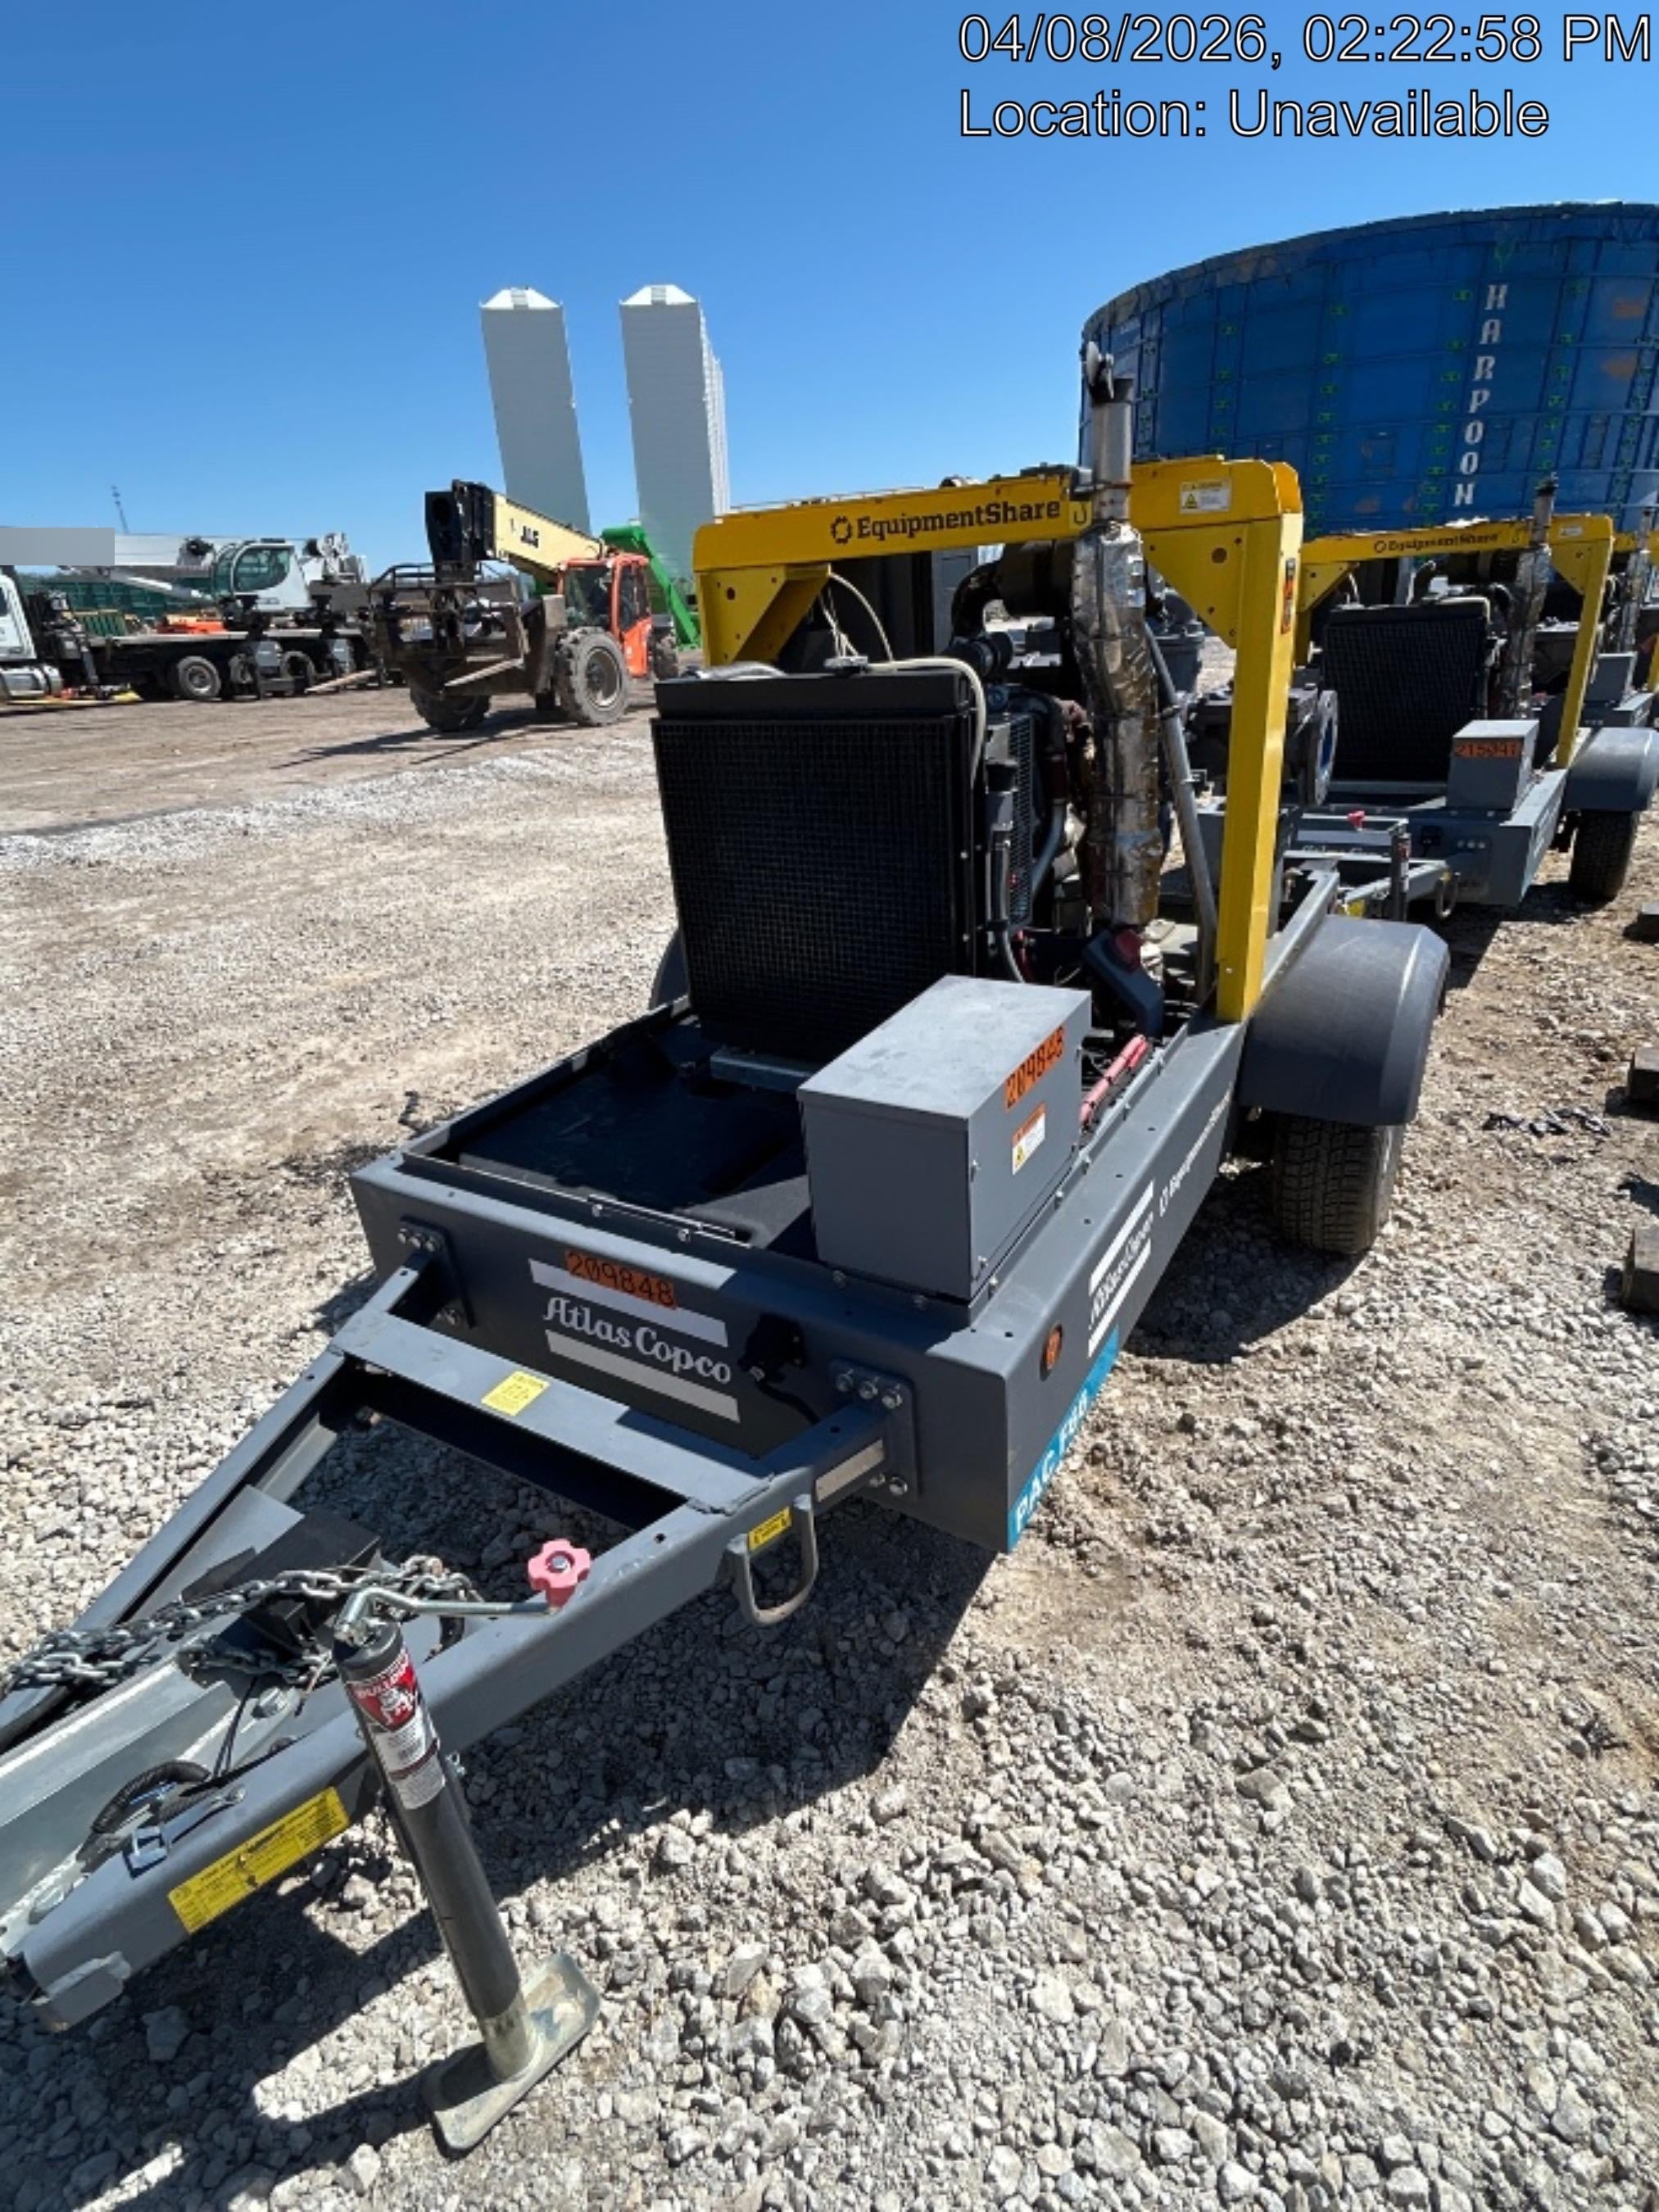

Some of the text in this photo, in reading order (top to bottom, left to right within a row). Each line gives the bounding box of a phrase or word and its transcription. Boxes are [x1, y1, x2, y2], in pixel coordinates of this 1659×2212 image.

[1453, 284, 1509, 507] HARPOON
[857, 500, 1060, 540] EquipmentShare
[568, 1252, 675, 1308] 209848
[543, 1296, 732, 1384] Atlas Copco
